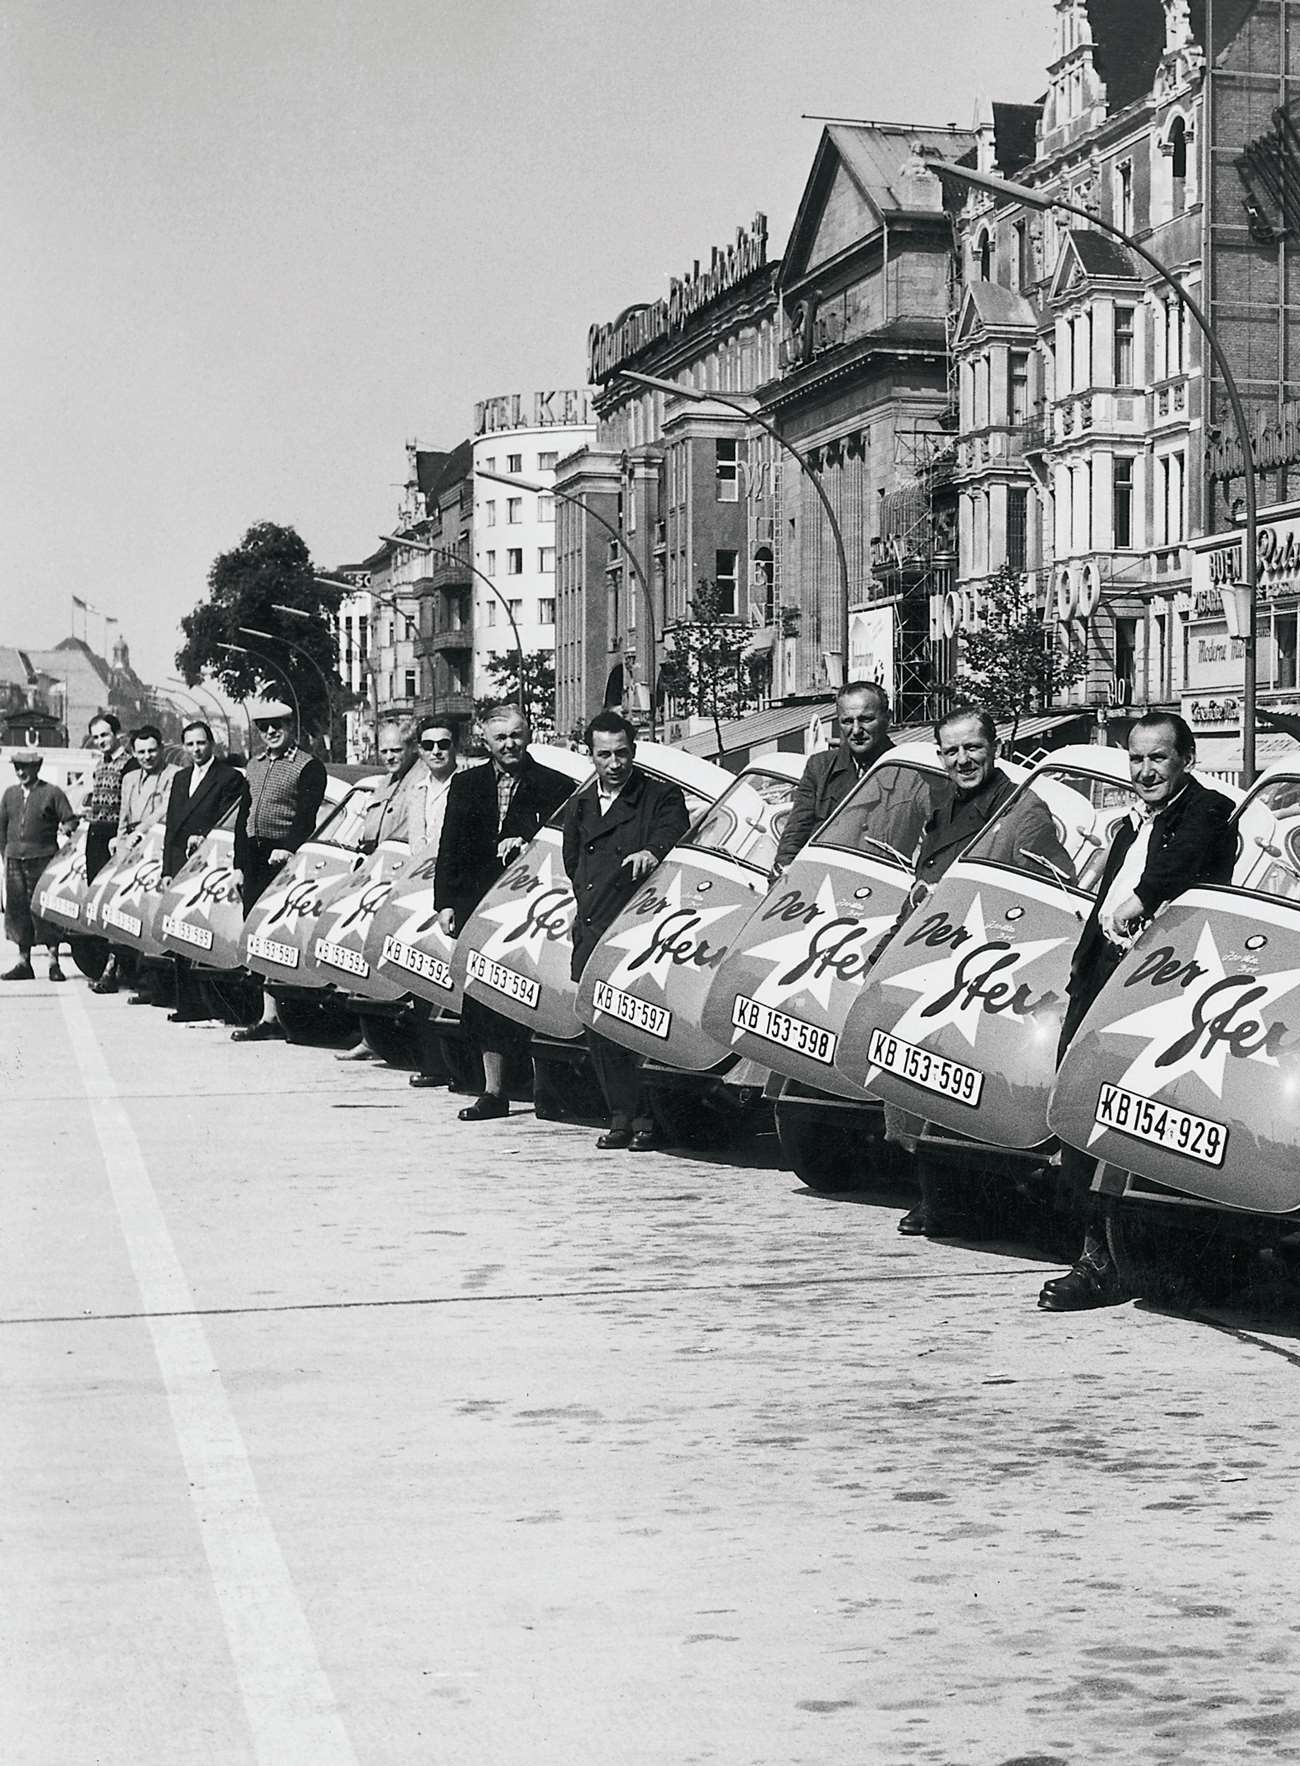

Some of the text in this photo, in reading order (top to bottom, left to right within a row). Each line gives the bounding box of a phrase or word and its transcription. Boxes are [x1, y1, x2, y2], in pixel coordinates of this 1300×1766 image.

[497, 865, 543, 893] Der
[623, 887, 672, 915] Der
[762, 890, 825, 923] Der
[903, 912, 973, 949] Der
[386, 940, 449, 984] KB 153-592
[470, 955, 535, 1008] KB 153-594
[1124, 946, 1208, 988] Der
[597, 985, 666, 1032] KB 153-597
[737, 1001, 829, 1057] KB 153-598
[872, 1032, 975, 1099] KB 153-599
